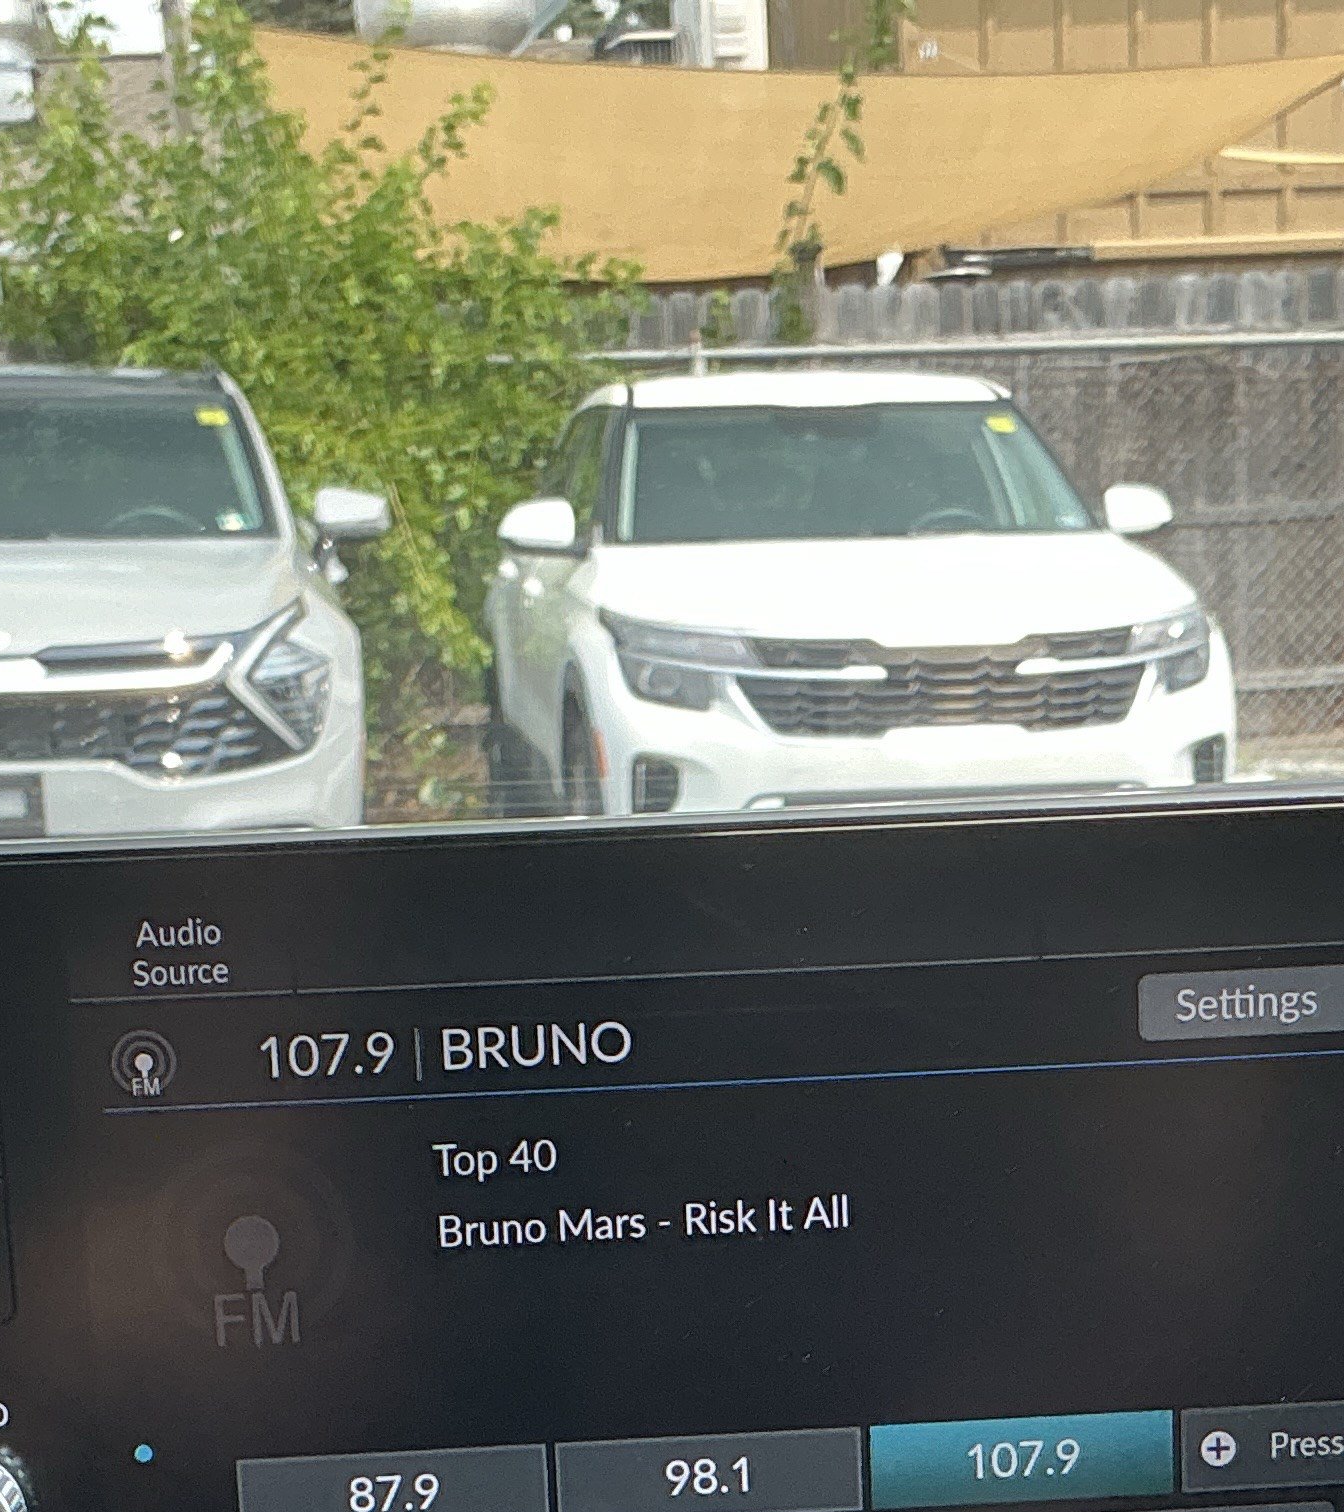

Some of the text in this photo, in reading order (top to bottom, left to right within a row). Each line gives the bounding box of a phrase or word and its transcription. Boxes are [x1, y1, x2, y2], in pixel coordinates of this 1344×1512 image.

[136, 918, 221, 948] Audio
[133, 960, 229, 987] Source
[1176, 984, 1318, 1024] Settings
[260, 1021, 632, 1078] 107.9 BRUNO
[131, 1078, 161, 1096] FM
[432, 1139, 557, 1183] Top 40
[439, 1215, 547, 1248] Bruno
[558, 1208, 646, 1242] Mars
[685, 1199, 757, 1236] Risk
[768, 1199, 794, 1231] It
[803, 1194, 849, 1230] All
[213, 1290, 300, 1348] FM
[963, 1436, 1081, 1479] 107.9
[1271, 1431, 1344, 1459] Press
[350, 1473, 439, 1512] 87.9
[665, 1456, 749, 1496] 98.1
